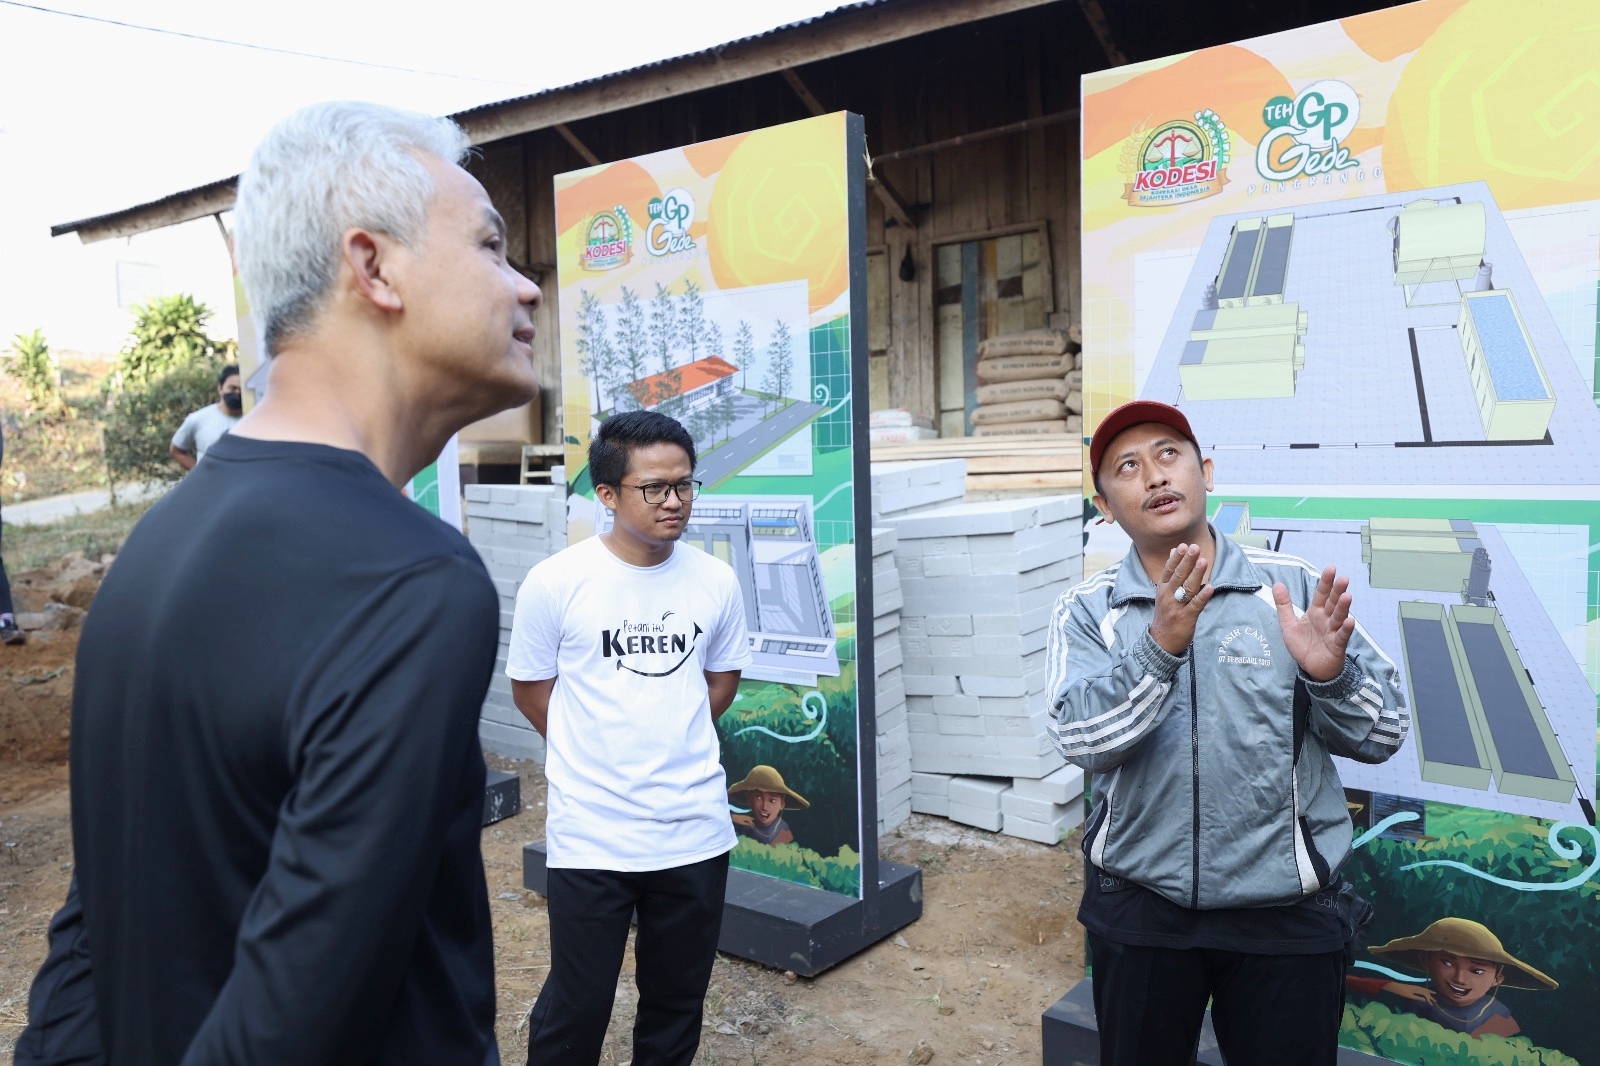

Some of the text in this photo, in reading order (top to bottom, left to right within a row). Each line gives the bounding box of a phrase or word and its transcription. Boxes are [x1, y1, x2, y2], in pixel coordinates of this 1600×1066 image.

[1265, 91, 1349, 141] TEH GP
[1256, 125, 1360, 182] Gede
[1134, 160, 1217, 191] KODESI
[1247, 167, 1383, 196] PANGRANGO
[1139, 186, 1211, 202] SEJAHTERA INDONESIA
[1151, 187, 1181, 195] KOPERASI
[649, 196, 690, 229] TEH GP
[585, 240, 627, 259] KODESI
[645, 218, 697, 257] Gede
[623, 619, 665, 633] Petani itu
[602, 628, 686, 657] KEREN
[1218, 626, 1271, 657] PASIR CANAR
[1218, 655, 1226, 663] 07
[1227, 655, 1258, 665] FEBRUARI
